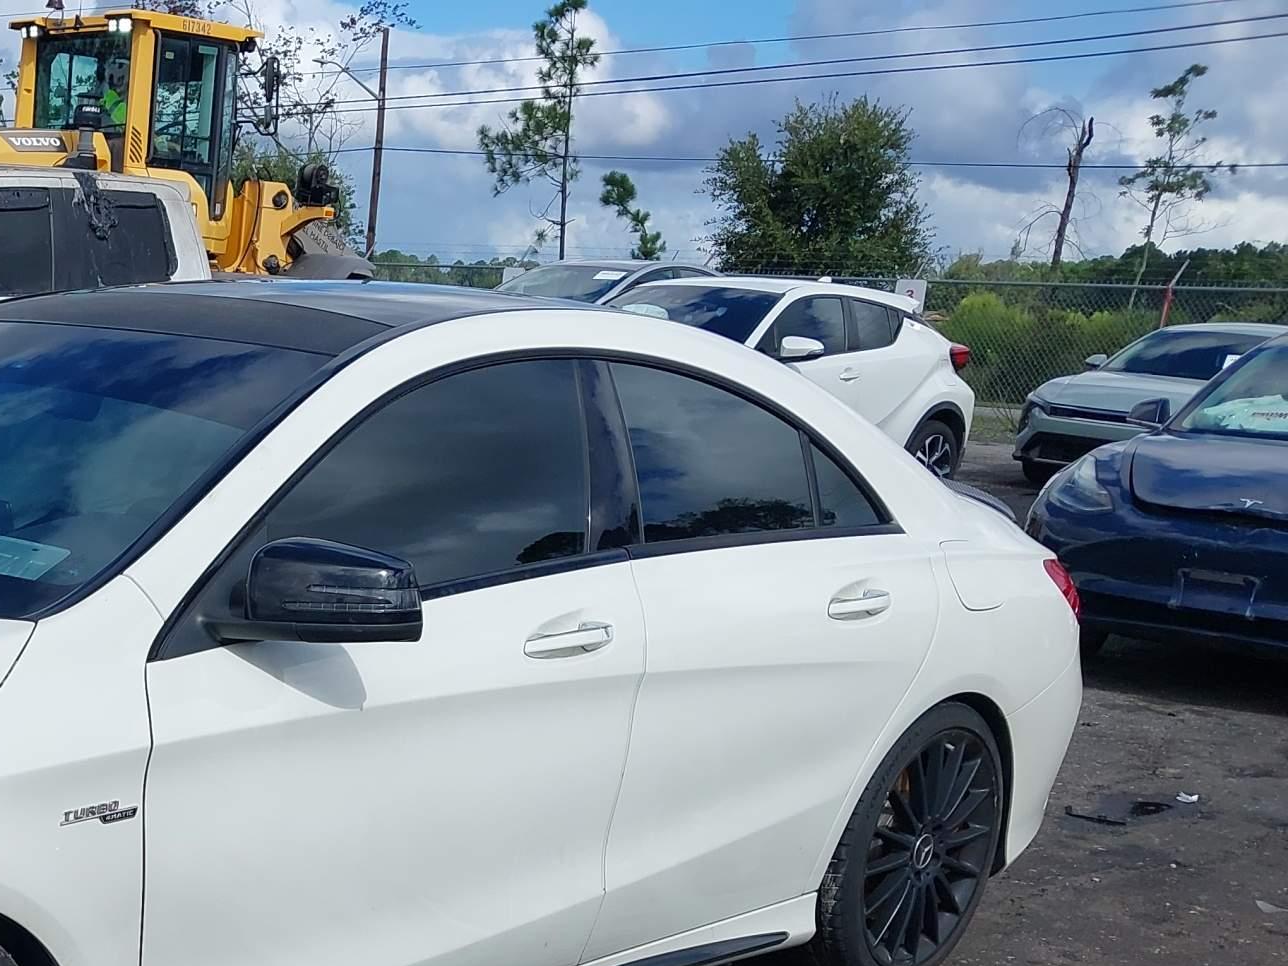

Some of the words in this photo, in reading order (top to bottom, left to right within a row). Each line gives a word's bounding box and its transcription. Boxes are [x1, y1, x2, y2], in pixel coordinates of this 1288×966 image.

[182, 19, 212, 35] 617342
[8, 137, 61, 147] VOLVO
[63, 800, 120, 822] TURBO
